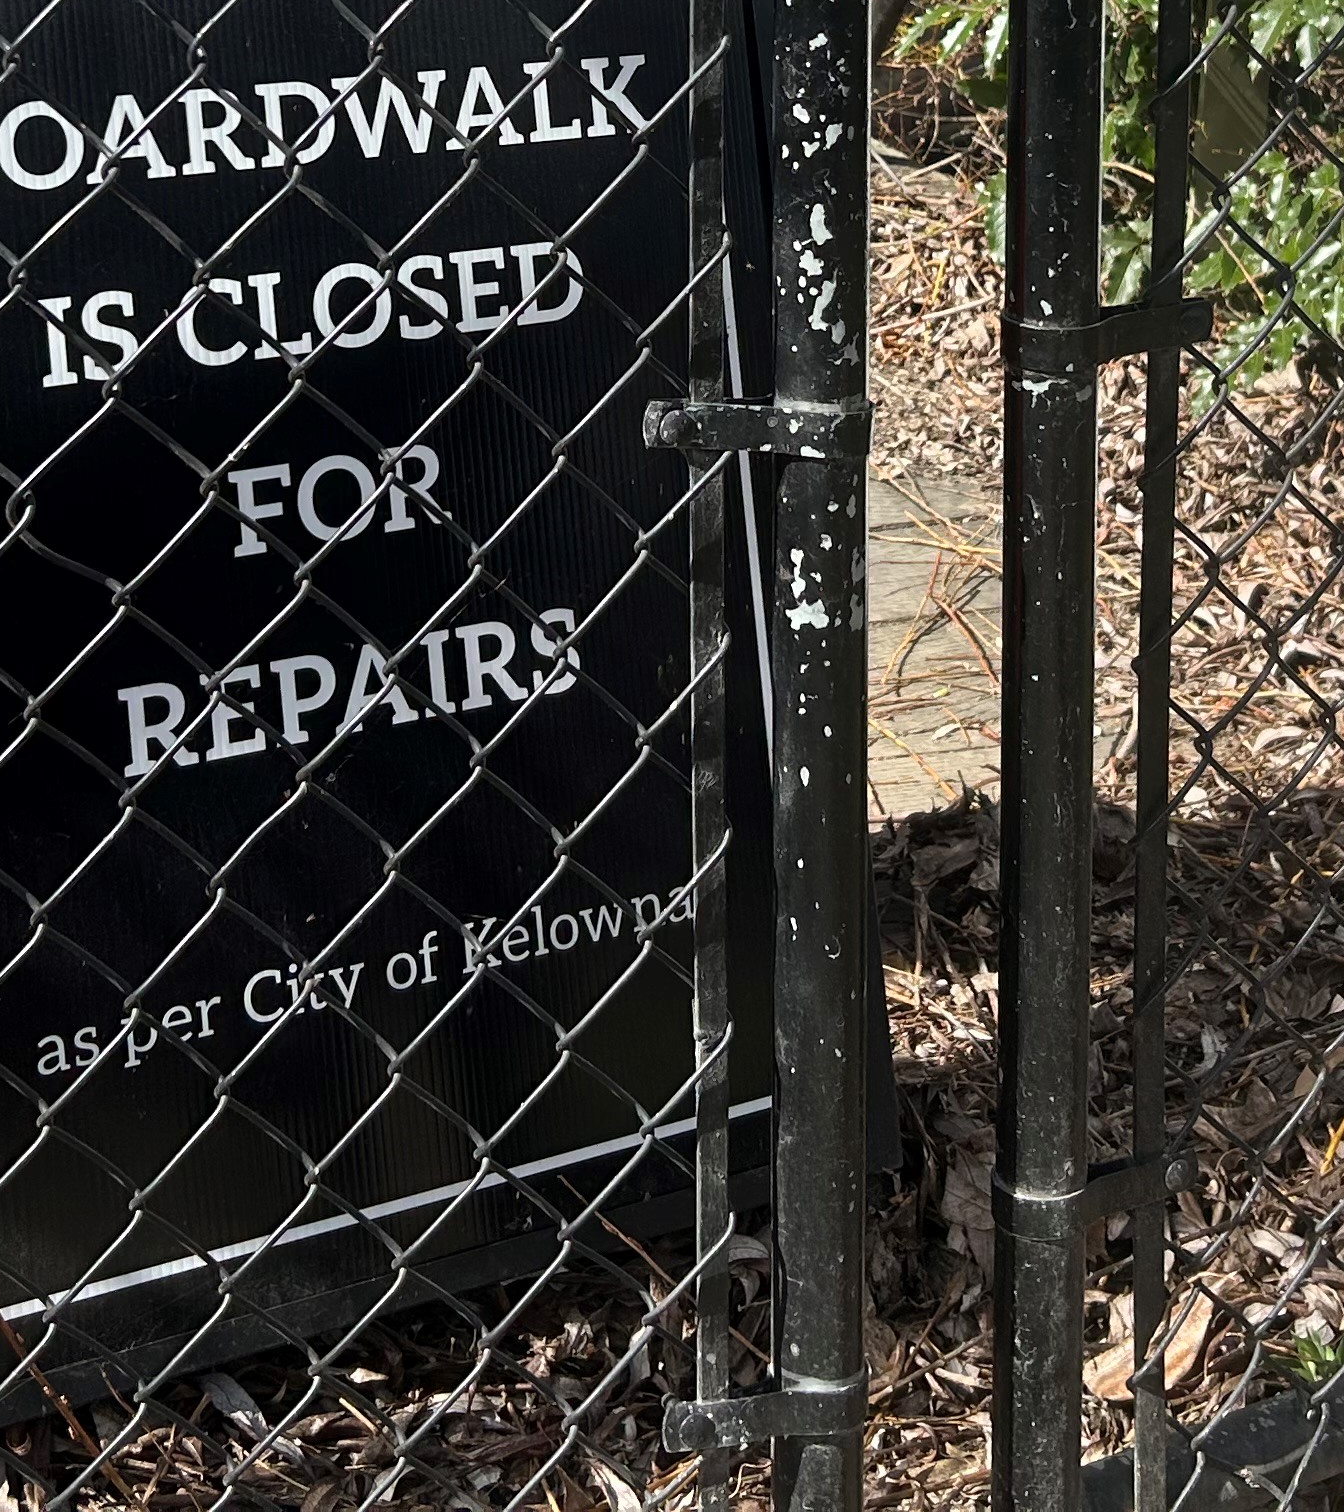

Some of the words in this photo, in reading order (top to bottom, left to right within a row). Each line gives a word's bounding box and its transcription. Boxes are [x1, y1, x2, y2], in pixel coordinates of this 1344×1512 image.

[40, 290, 140, 388] IS
[178, 241, 584, 368] CLOSED
[227, 445, 452, 558] FOR
[117, 608, 582, 778] REPAIRS
[36, 1026, 101, 1076] as
[123, 995, 223, 1068] per
[243, 962, 366, 1023] City
[386, 930, 439, 989] of
[462, 884, 697, 975] Kelowna
